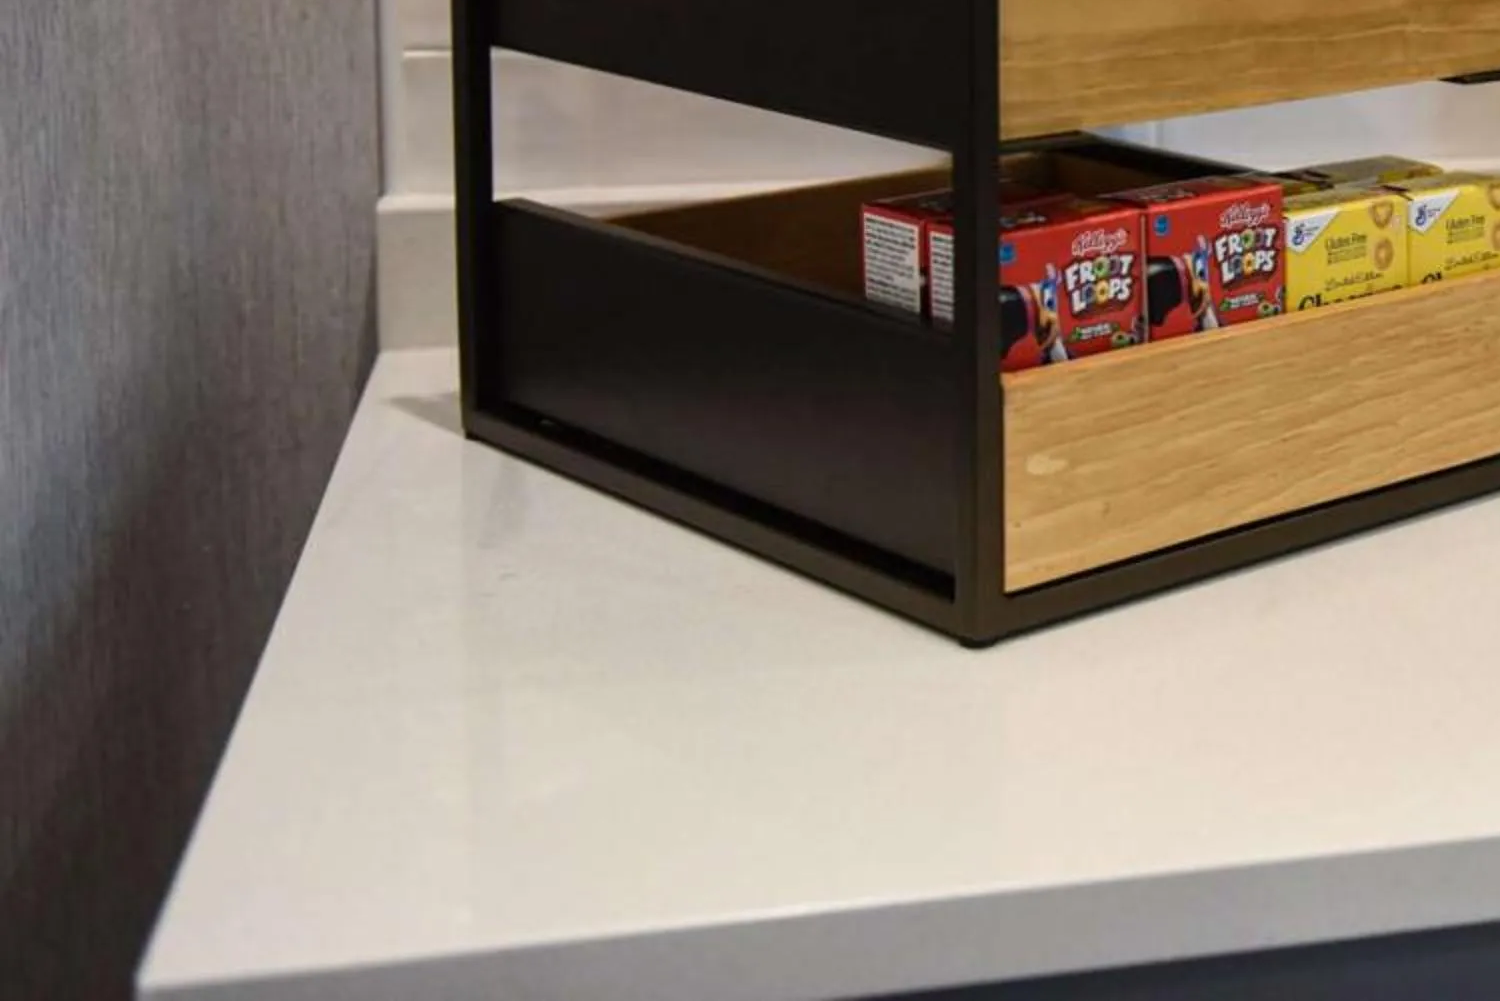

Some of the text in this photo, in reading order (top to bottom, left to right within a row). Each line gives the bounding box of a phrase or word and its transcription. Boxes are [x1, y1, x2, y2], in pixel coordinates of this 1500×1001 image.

[1215, 228, 1276, 262] FROOT
[1065, 254, 1133, 290] FROOT
[1222, 250, 1276, 283] LOOPS
[1072, 277, 1132, 314] LOOPS
